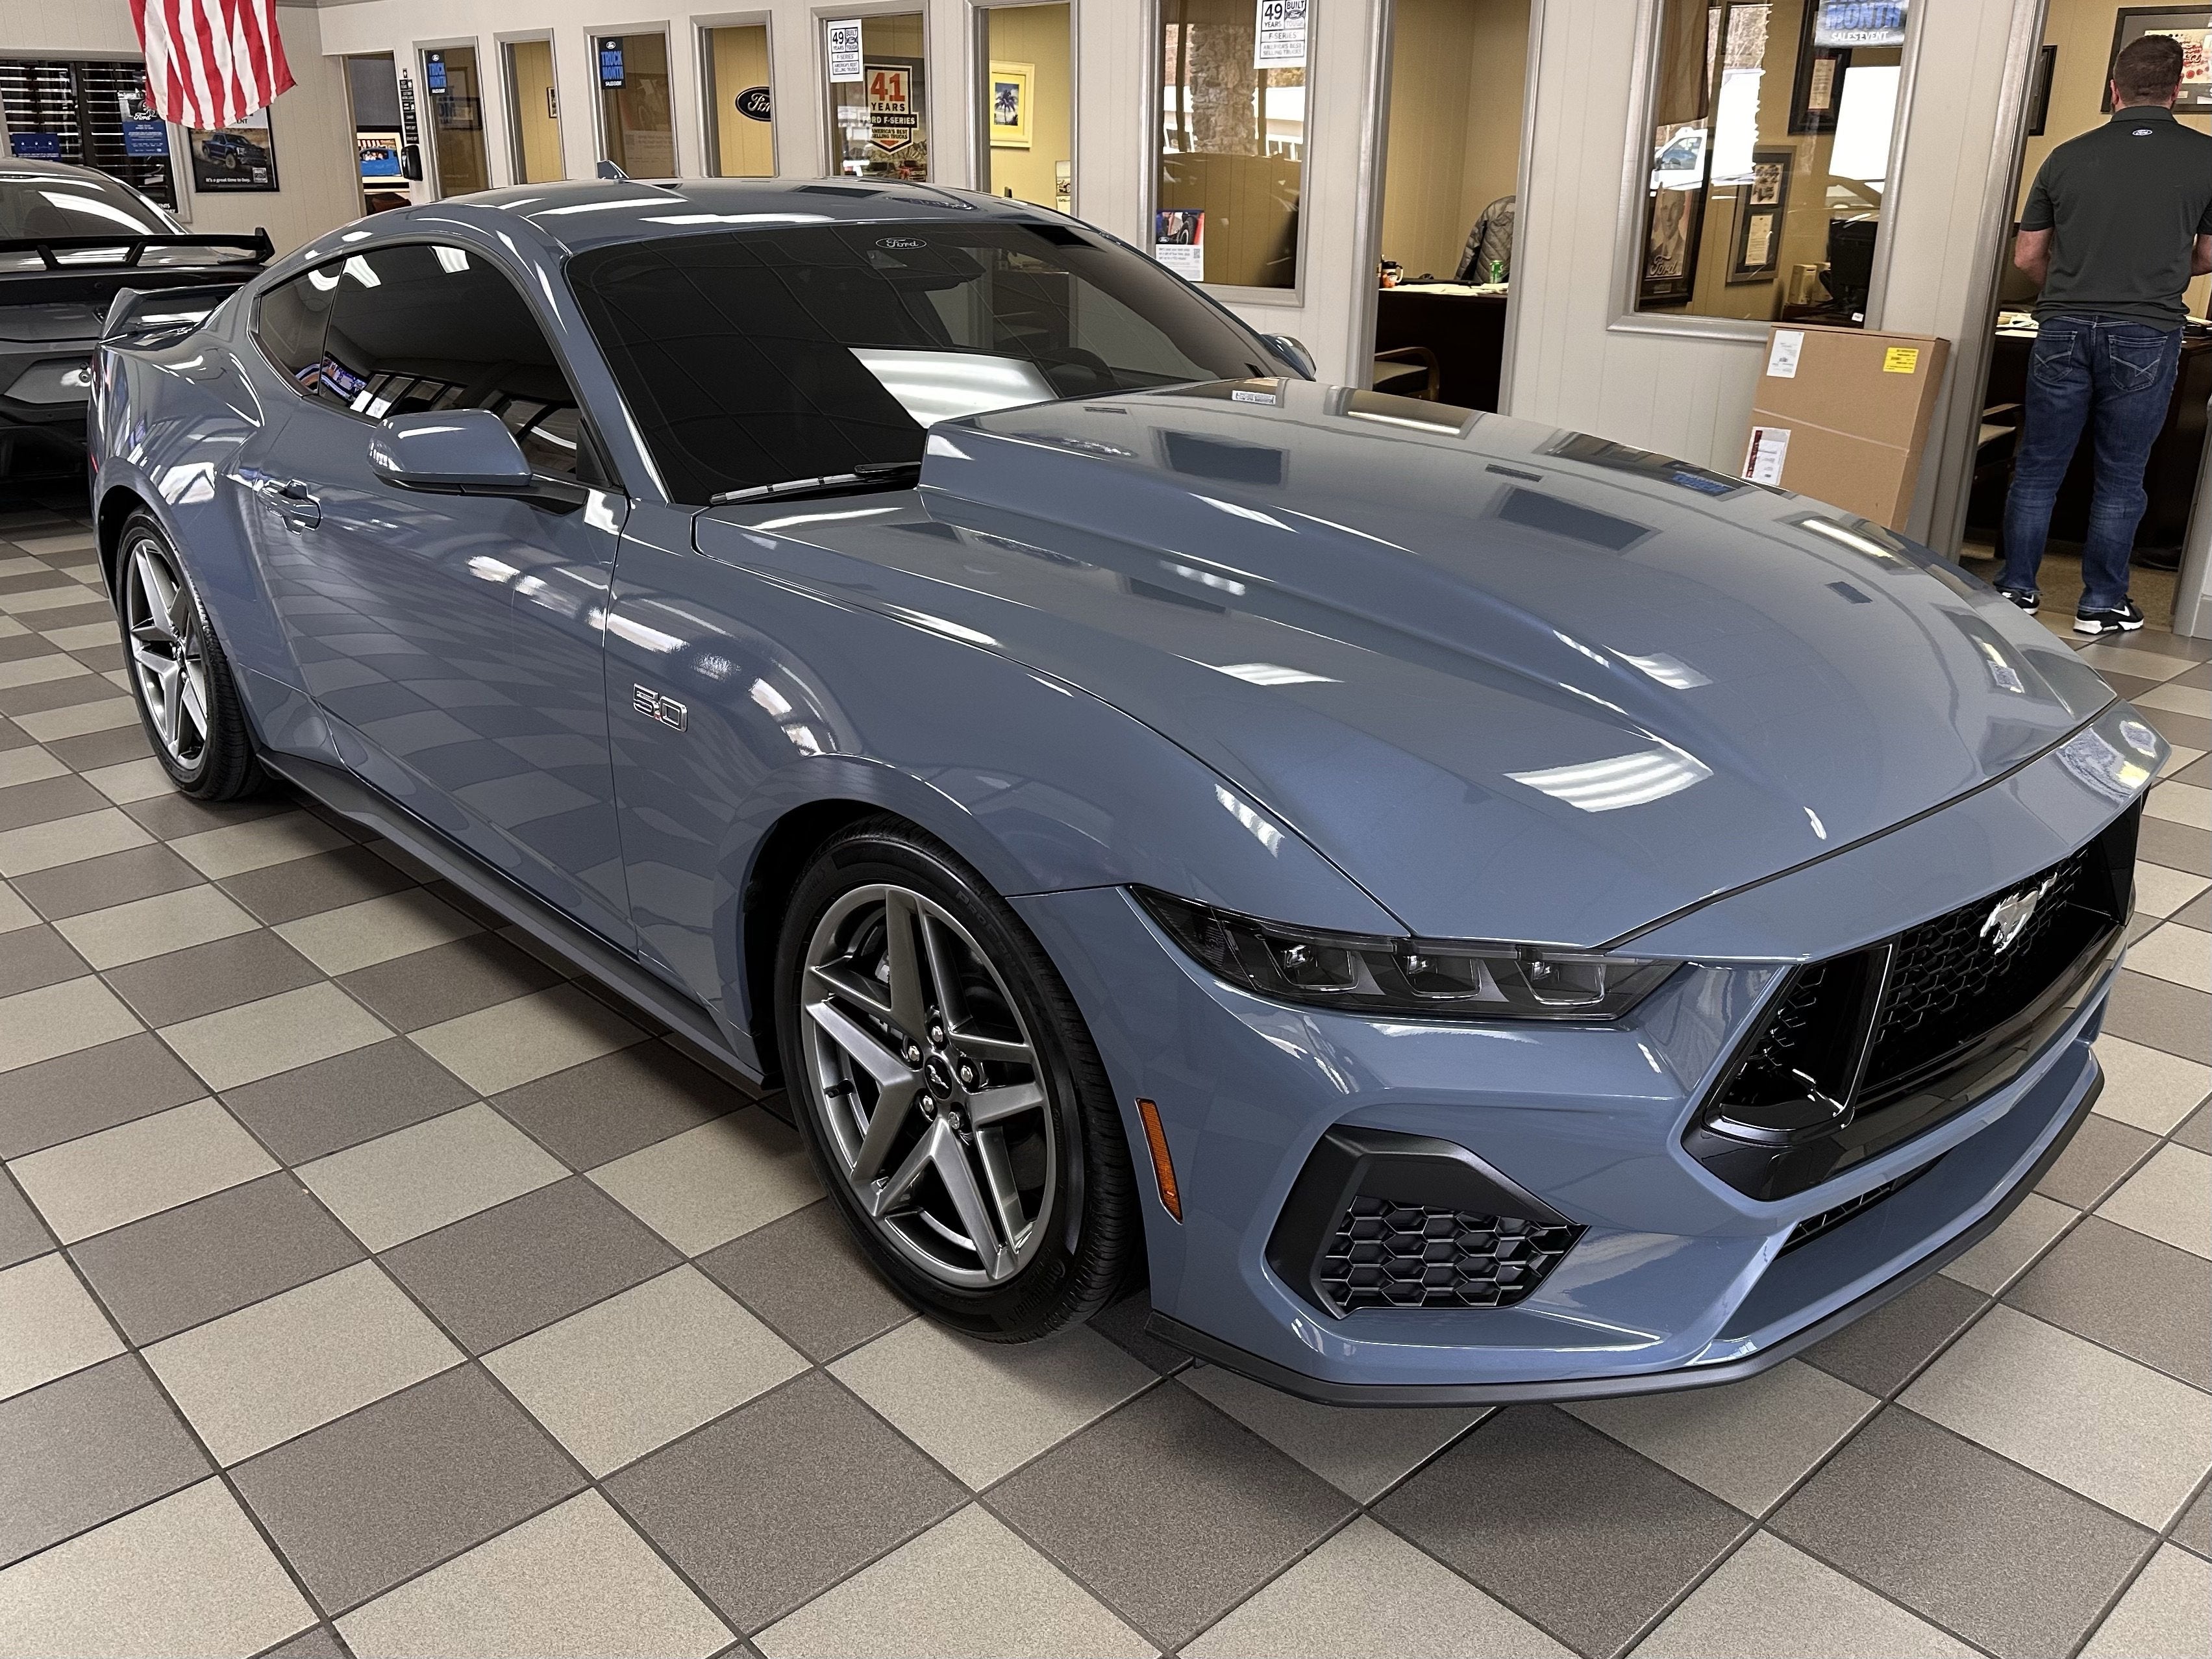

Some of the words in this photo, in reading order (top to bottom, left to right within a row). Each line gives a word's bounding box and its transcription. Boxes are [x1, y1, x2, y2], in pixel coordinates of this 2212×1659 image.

[1287, 0, 1304, 9] BUILT
[1264, 3, 1283, 20] 49
[1826, 3, 1902, 29] MONTH
[832, 31, 844, 44] 49
[1831, 31, 1858, 41] SALES
[1858, 31, 1889, 40] EVENT
[601, 51, 623, 66] TRUCK
[602, 66, 624, 79] MONTH
[871, 72, 906, 102] 41
[871, 102, 906, 112] YEARS
[884, 116, 915, 125] F-SERIES
[886, 238, 919, 247] Ford
[1650, 254, 1678, 276] Ford
[632, 682, 688, 733] 5.0
